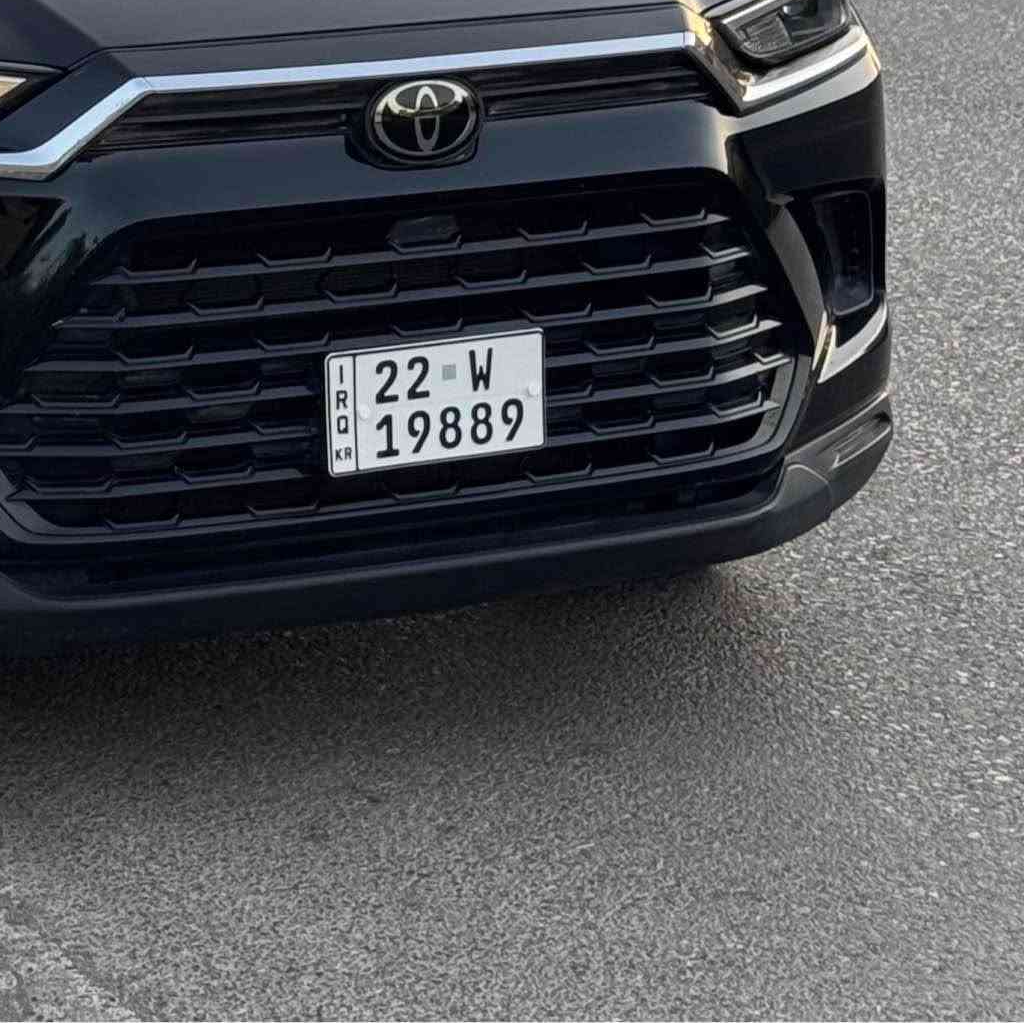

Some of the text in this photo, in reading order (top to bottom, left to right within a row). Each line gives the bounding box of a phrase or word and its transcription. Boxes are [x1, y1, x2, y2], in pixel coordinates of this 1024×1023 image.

[335, 364, 349, 435] IRQ
[375, 347, 494, 405] 22 W
[335, 446, 353, 462] KR
[375, 397, 525, 460] 19889
